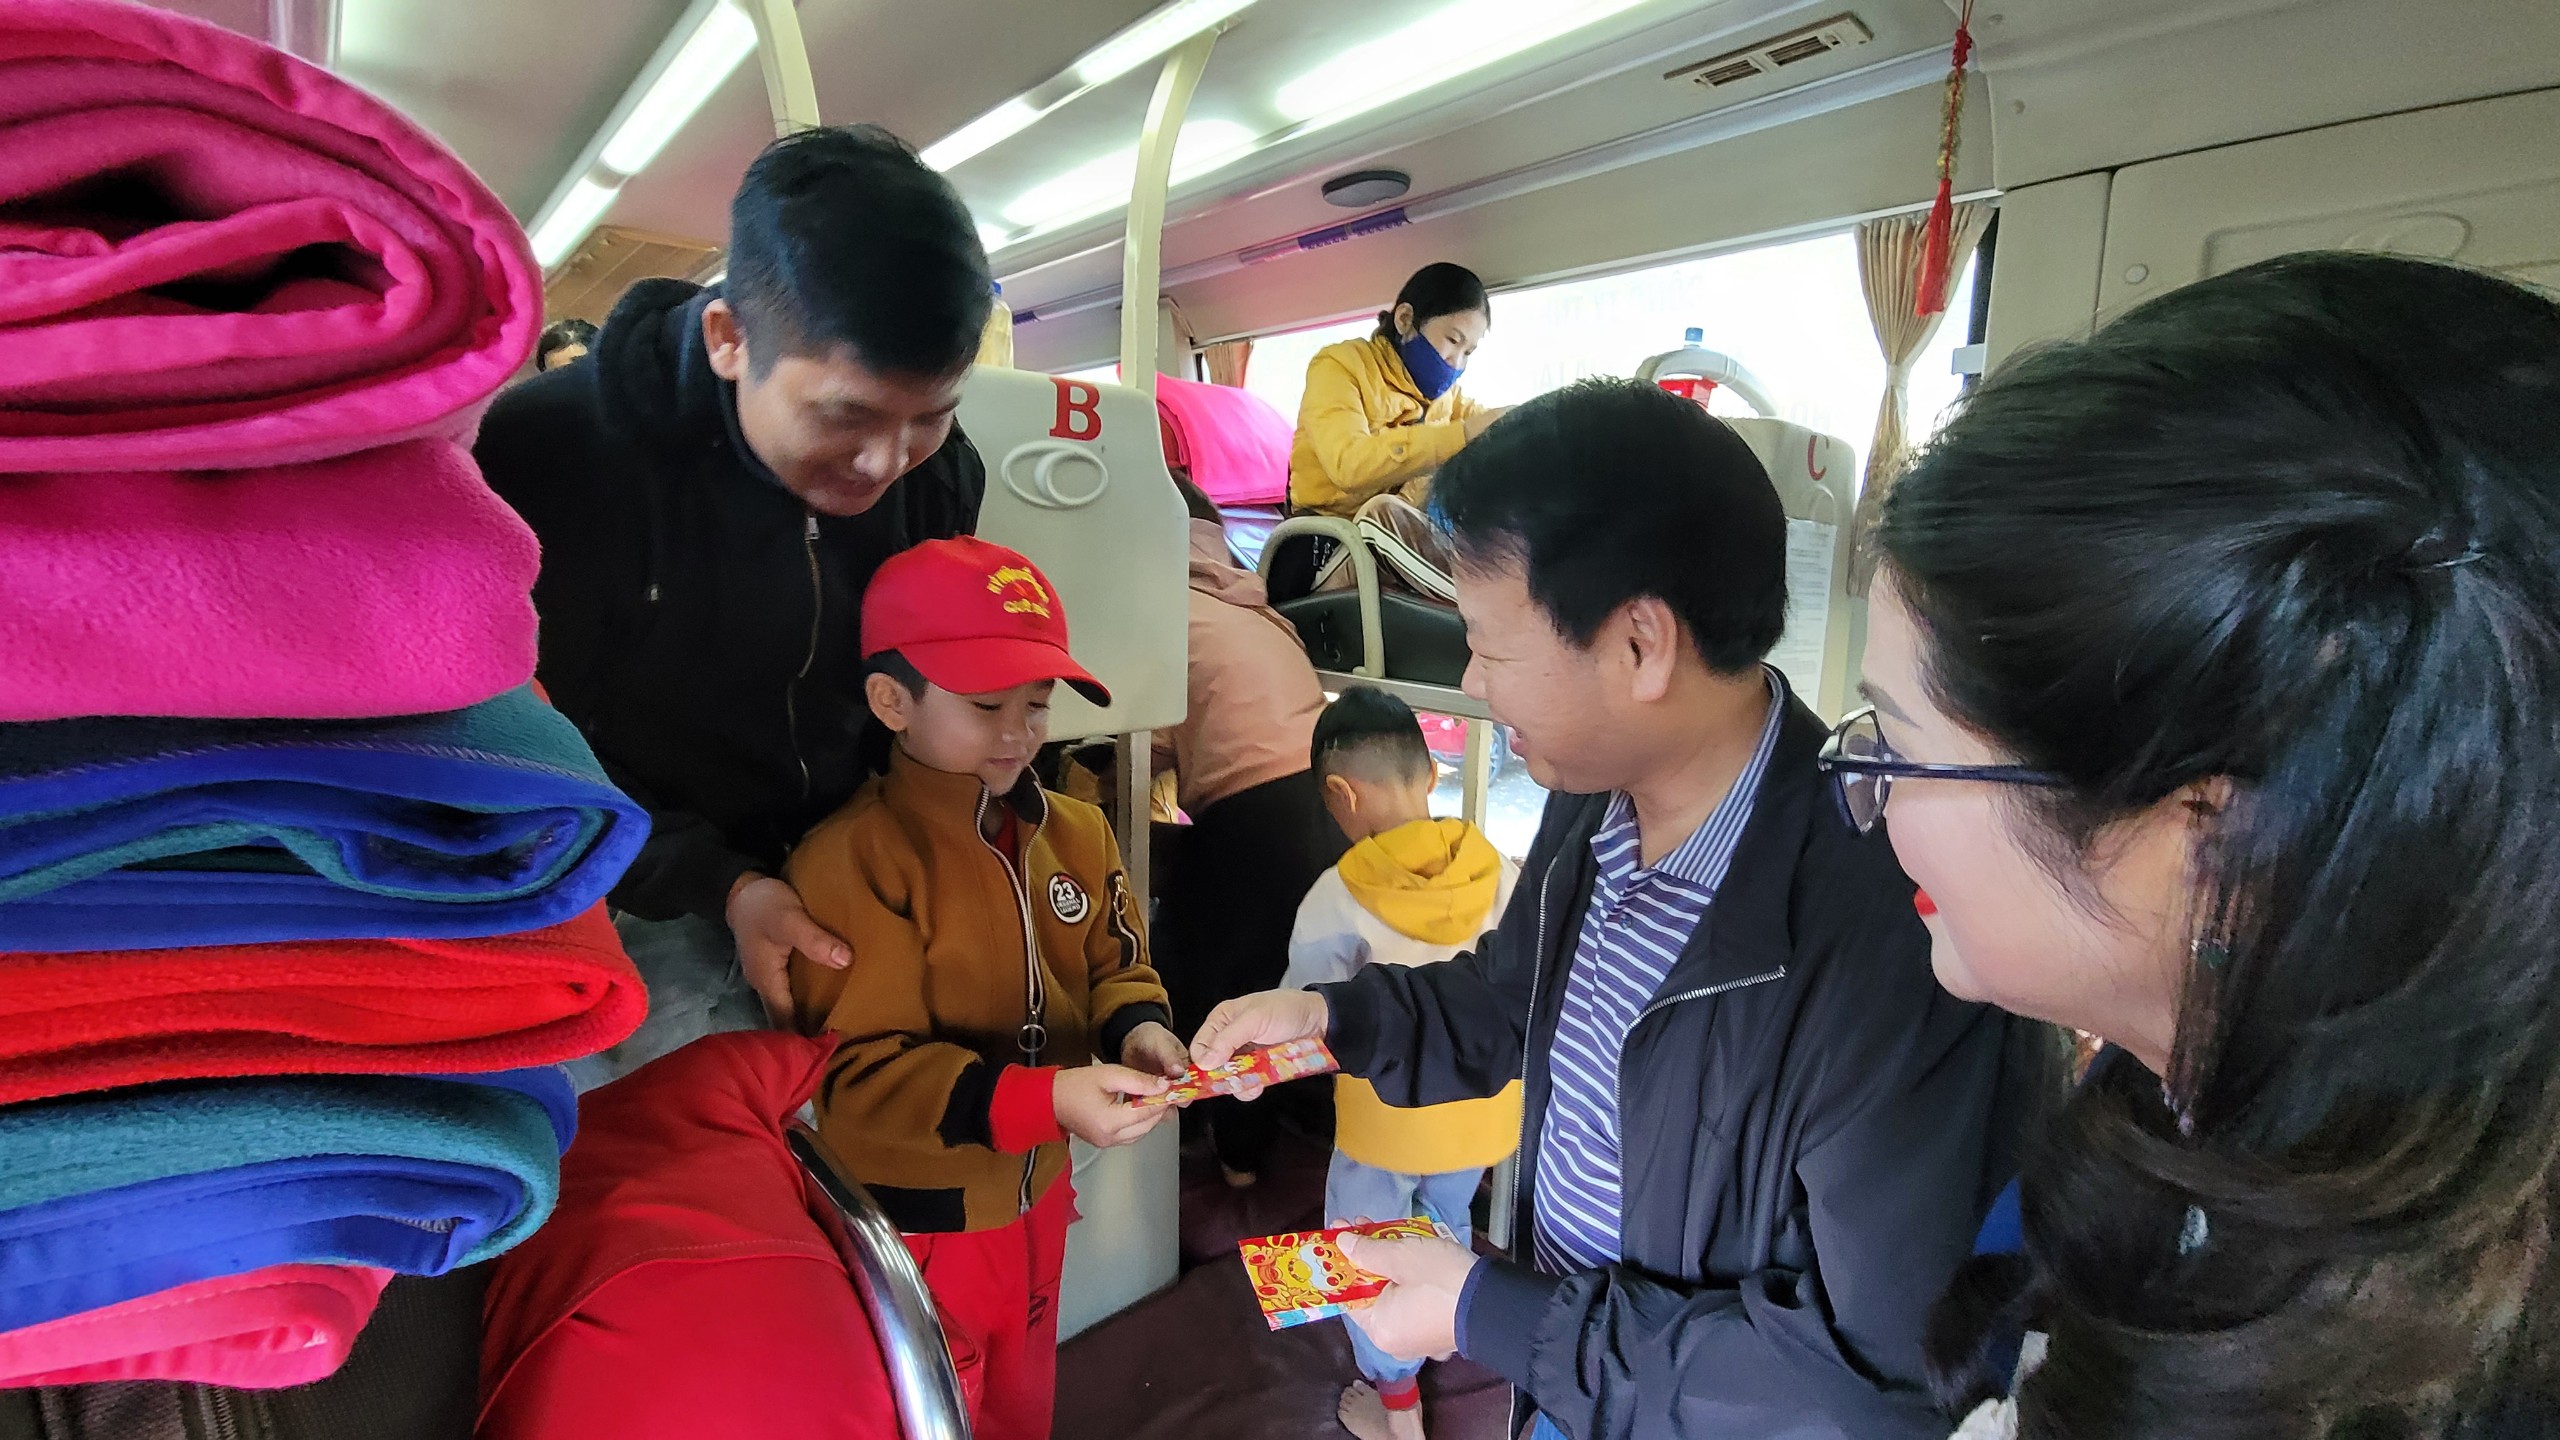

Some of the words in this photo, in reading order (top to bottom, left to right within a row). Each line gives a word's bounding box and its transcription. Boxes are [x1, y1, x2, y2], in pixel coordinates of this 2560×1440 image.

[1049, 377, 1102, 441] B
[1807, 433, 1830, 481] C
[1054, 882, 1076, 901] 23
